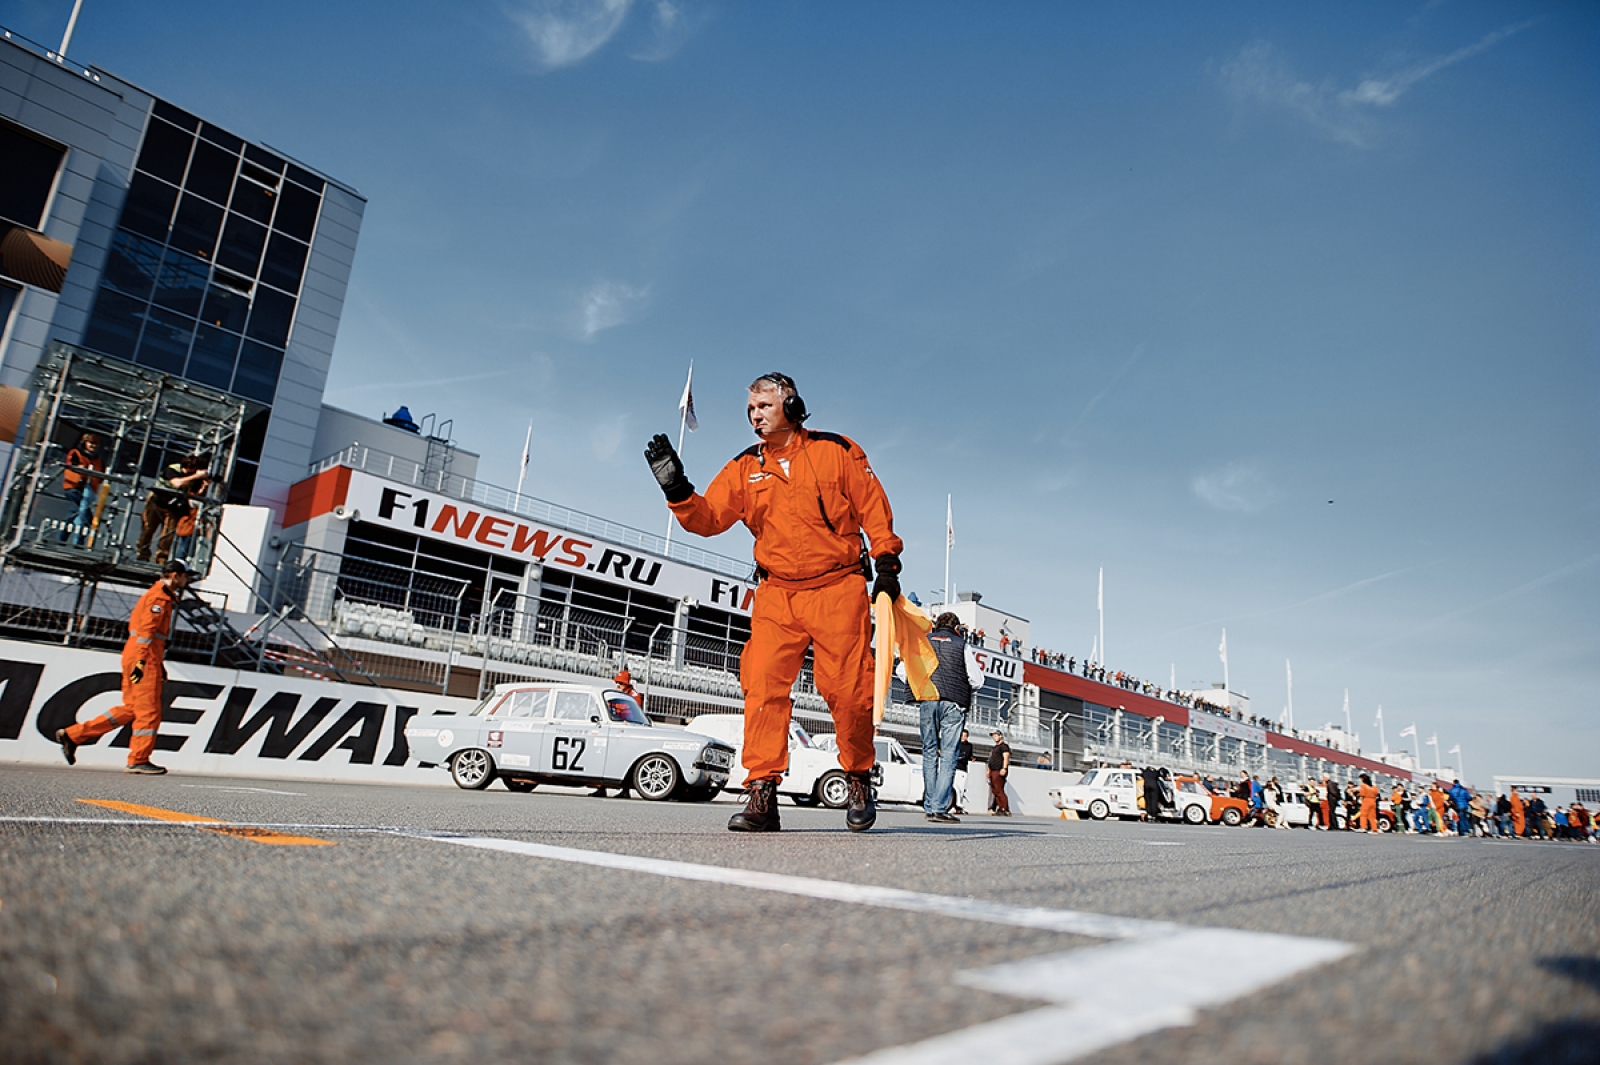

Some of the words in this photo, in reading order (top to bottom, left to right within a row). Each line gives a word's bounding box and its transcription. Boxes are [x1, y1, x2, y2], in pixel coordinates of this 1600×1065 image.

[378, 487, 662, 586] F1NEWS.RU
[972, 652, 1016, 679] S.RU
[552, 736, 585, 771] 62
